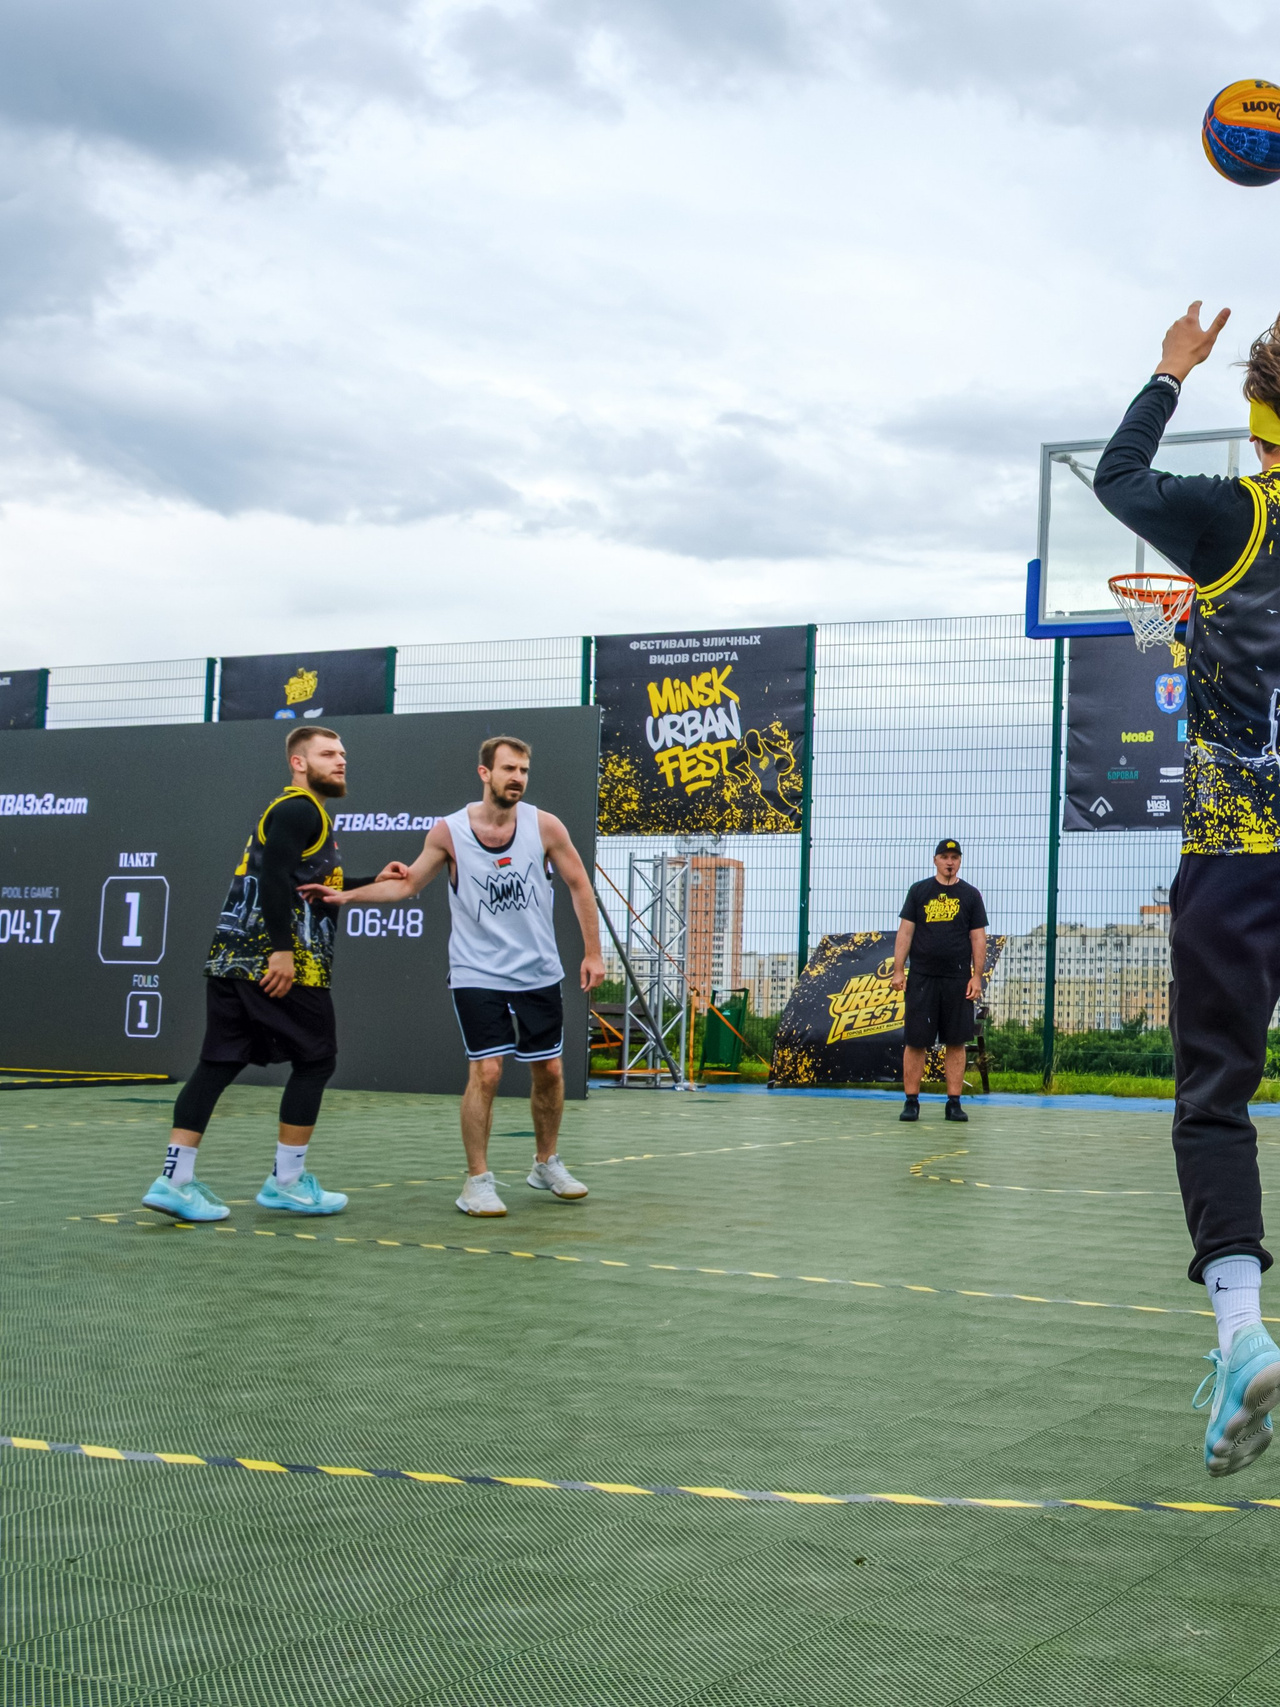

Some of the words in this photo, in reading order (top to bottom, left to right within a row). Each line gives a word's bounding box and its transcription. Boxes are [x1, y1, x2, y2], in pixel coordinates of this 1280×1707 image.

[629, 638, 700, 650] ФЕСТИВАЛЬ
[702, 635, 761, 647] УЛИЧНЫХ
[649, 653, 690, 665] ВИДОВ
[691, 651, 739, 663] СПОРТА
[645, 700, 741, 752] URBAN
[655, 739, 738, 788] FEST
[0, 793, 88, 816] IBA3x3.com
[119, 852, 157, 867] ПАКЕТ
[1, 886, 23, 899] POOL
[24, 887, 30, 898] E
[30, 887, 54, 898] GAME
[55, 887, 60, 898] 1
[926, 904, 959, 913] URBAN
[929, 911, 956, 920] FEST
[0, 909, 61, 944] 04:17
[122, 892, 142, 947] 1
[346, 908, 424, 937] 06:48
[132, 974, 159, 988] FOULS
[844, 975, 893, 995] MIN
[833, 987, 905, 1013] URBA
[137, 1000, 148, 1029] 1
[833, 1002, 906, 1038] FEST
[1249, 1336, 1272, 1353] NIK
